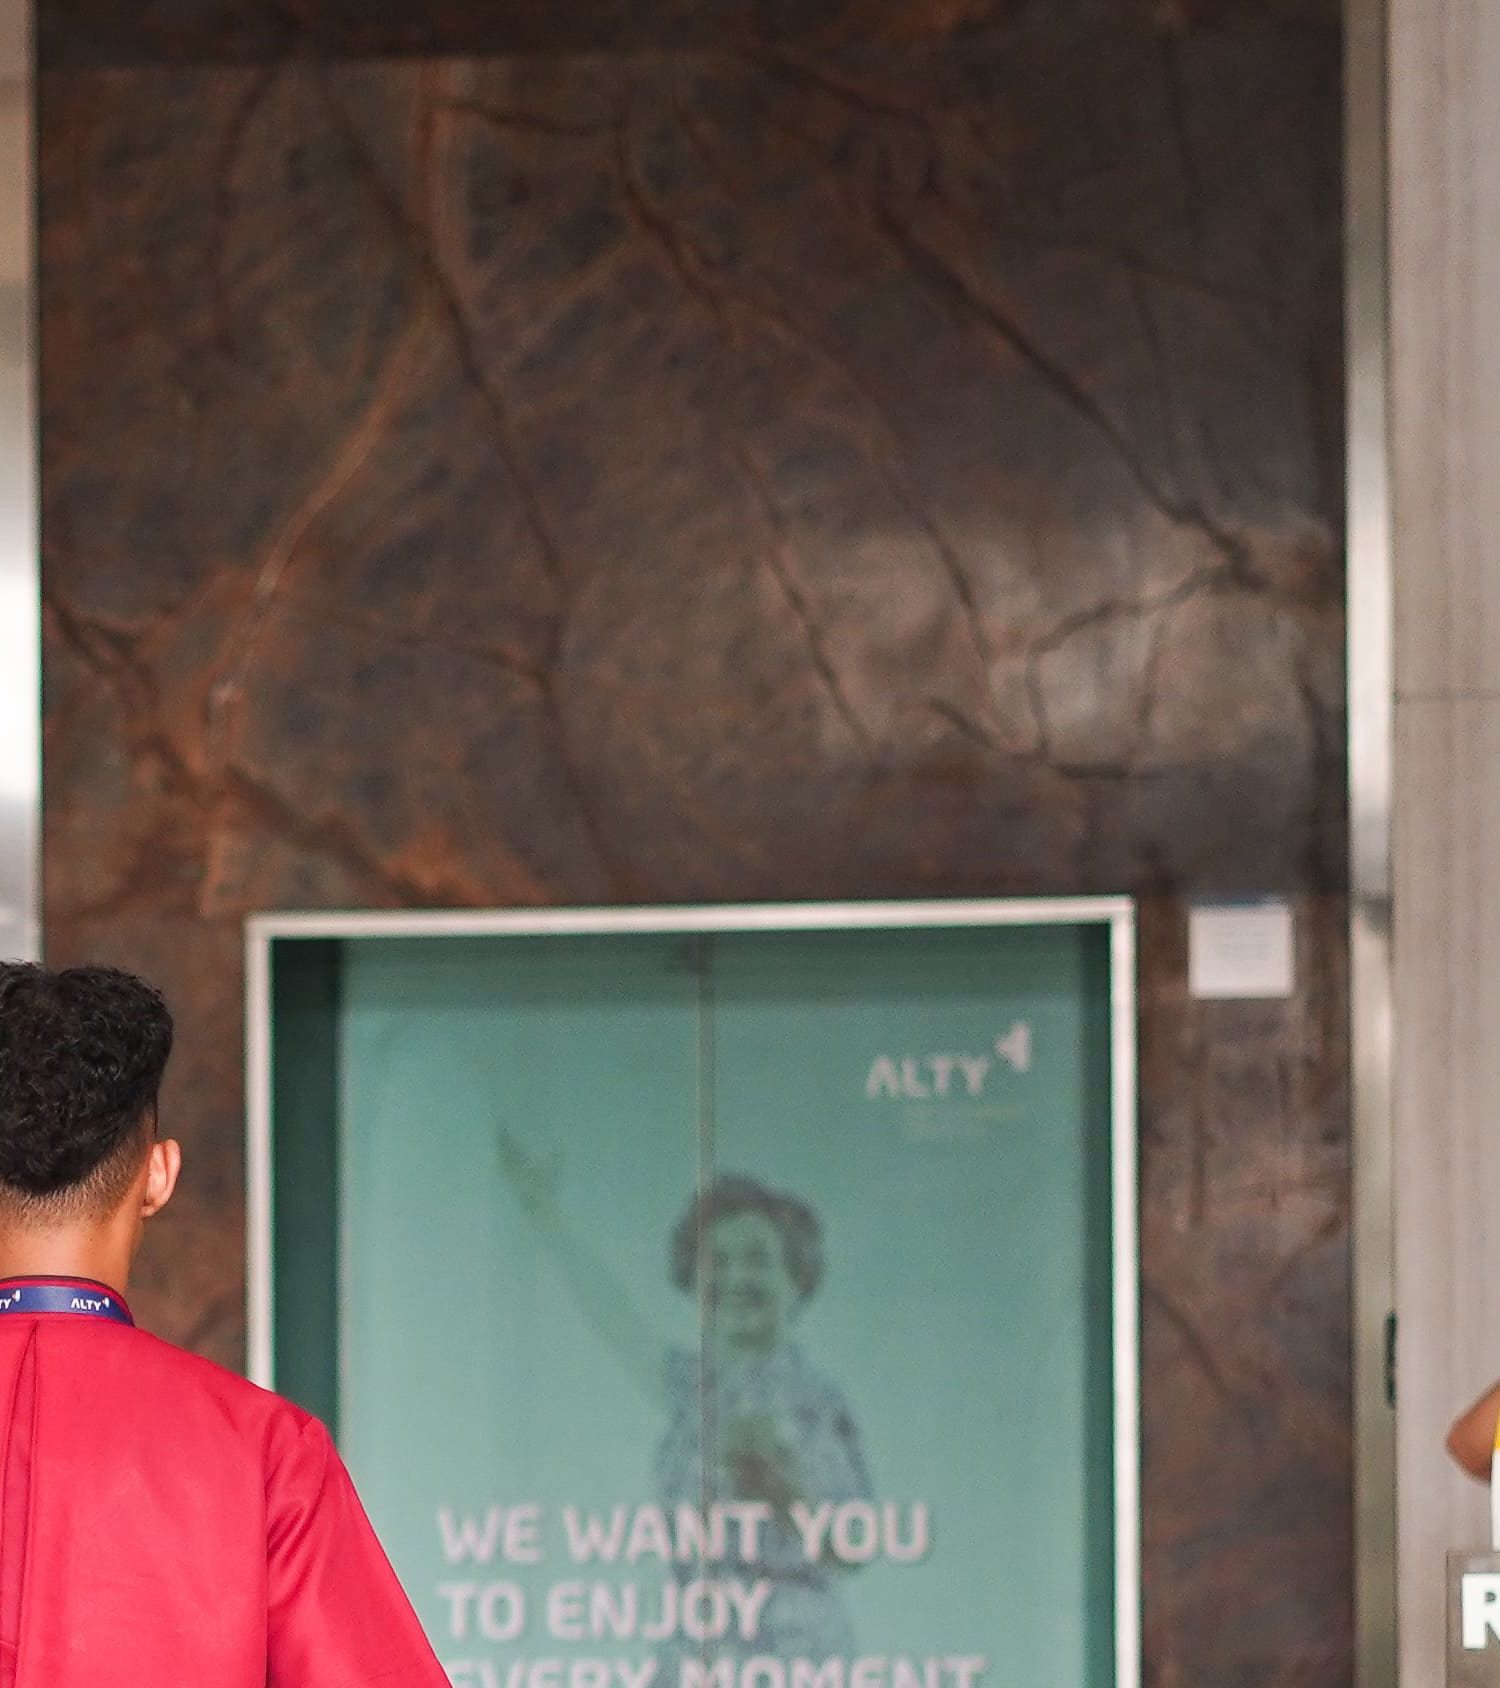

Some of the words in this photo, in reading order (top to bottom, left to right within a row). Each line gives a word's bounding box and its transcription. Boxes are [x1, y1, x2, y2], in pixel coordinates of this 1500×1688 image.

[866, 1055, 990, 1099] ALTY
[71, 1298, 102, 1311] ALTY
[436, 1504, 542, 1564] WE
[562, 1503, 770, 1563] WANT
[790, 1502, 930, 1562] YOU
[436, 1581, 525, 1640] TO
[547, 1580, 772, 1641] ENJOY
